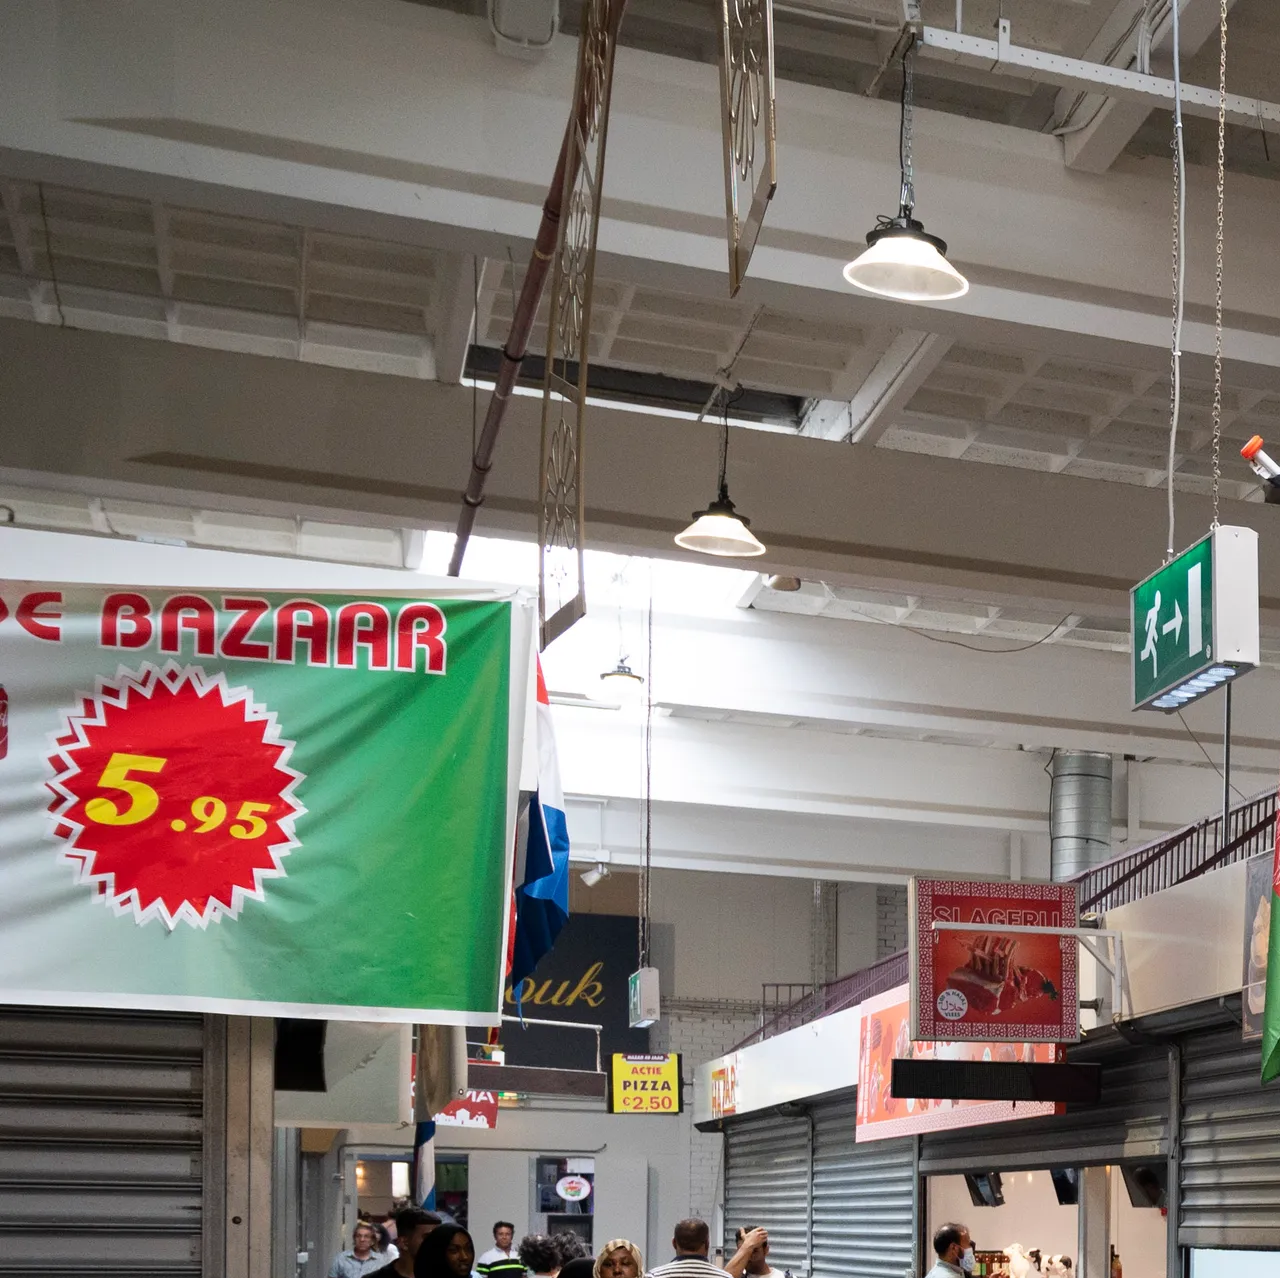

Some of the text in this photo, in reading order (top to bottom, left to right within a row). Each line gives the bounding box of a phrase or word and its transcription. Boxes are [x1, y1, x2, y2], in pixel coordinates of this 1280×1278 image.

[101, 592, 447, 674] BAZAAR
[504, 962, 606, 1008] ouk
[631, 1066, 662, 1075] ACTIE
[622, 1080, 672, 1091] PIZZA
